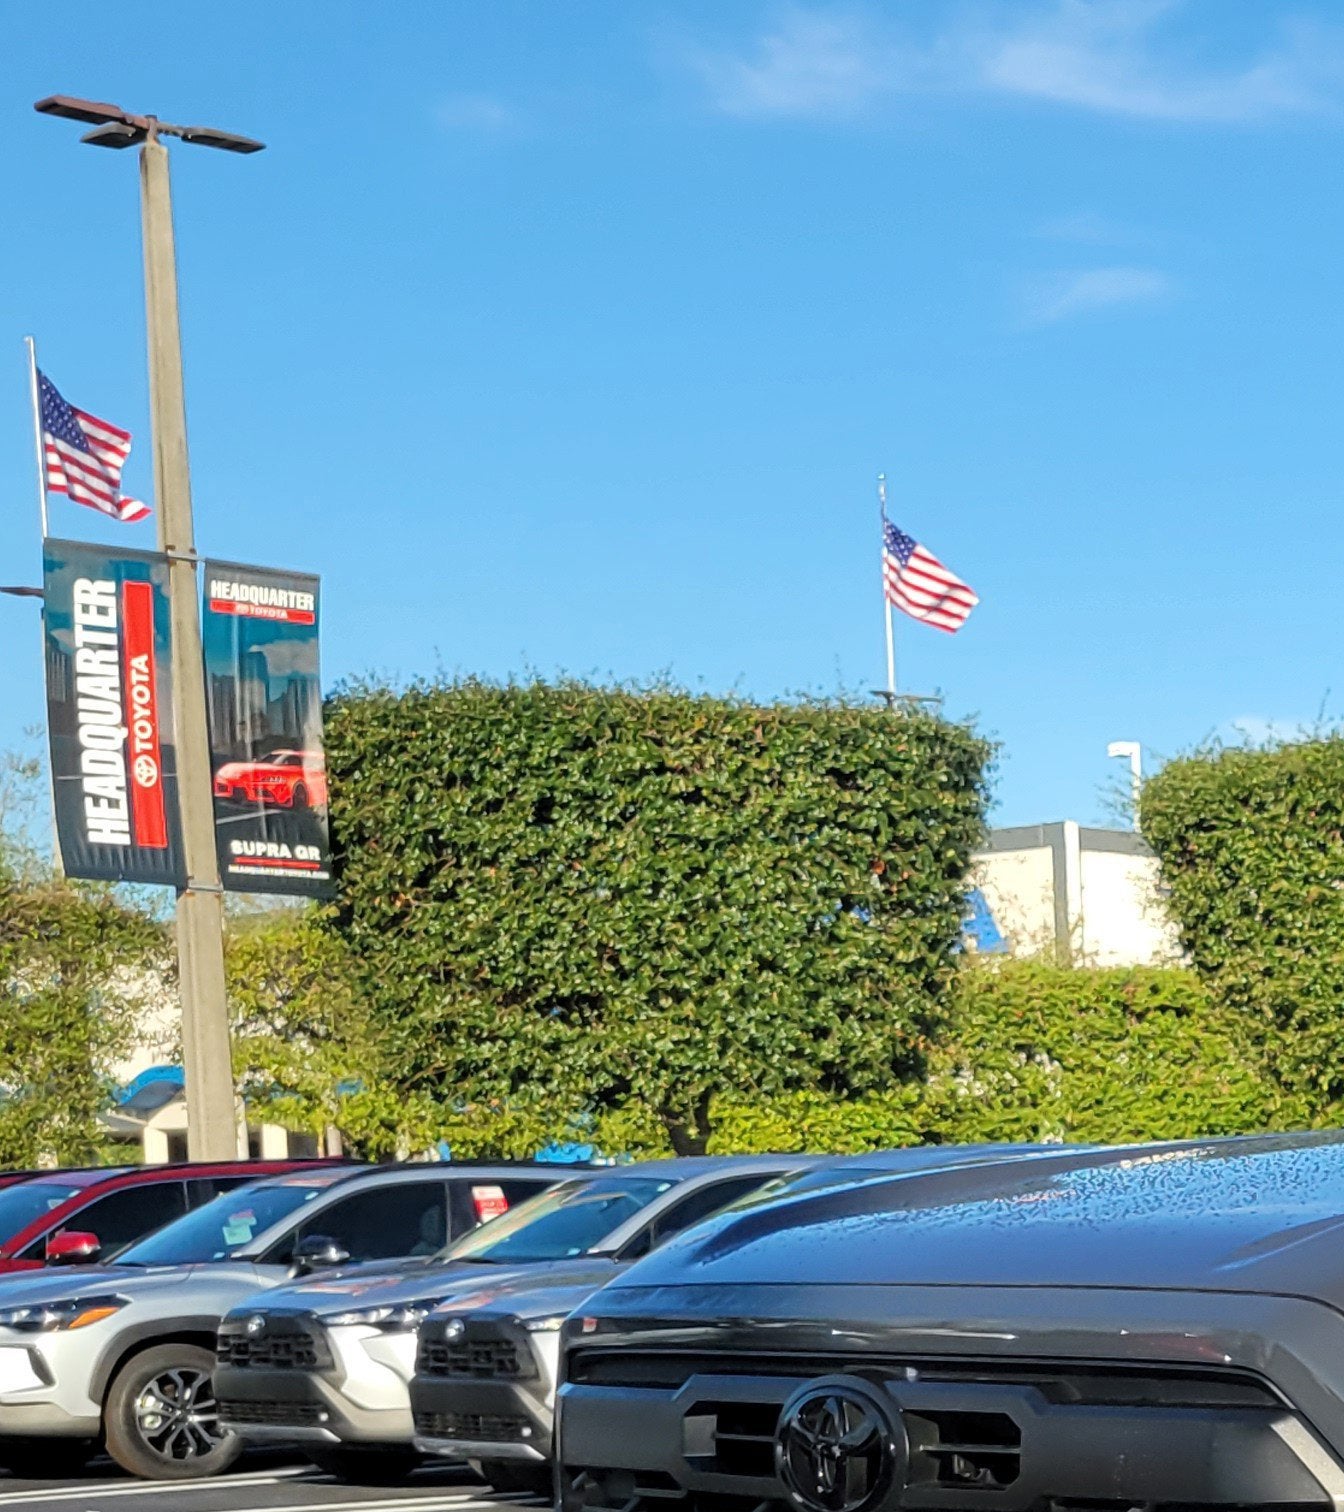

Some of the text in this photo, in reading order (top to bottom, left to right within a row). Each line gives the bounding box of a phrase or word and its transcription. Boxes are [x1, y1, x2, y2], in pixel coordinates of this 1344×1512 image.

[210, 579, 316, 612] HEADQUARTER
[248, 604, 289, 619] TOYOTA
[73, 577, 132, 846] HEADQUARTER
[129, 653, 154, 754] TOYOTA
[229, 838, 322, 861] SUPRA GR
